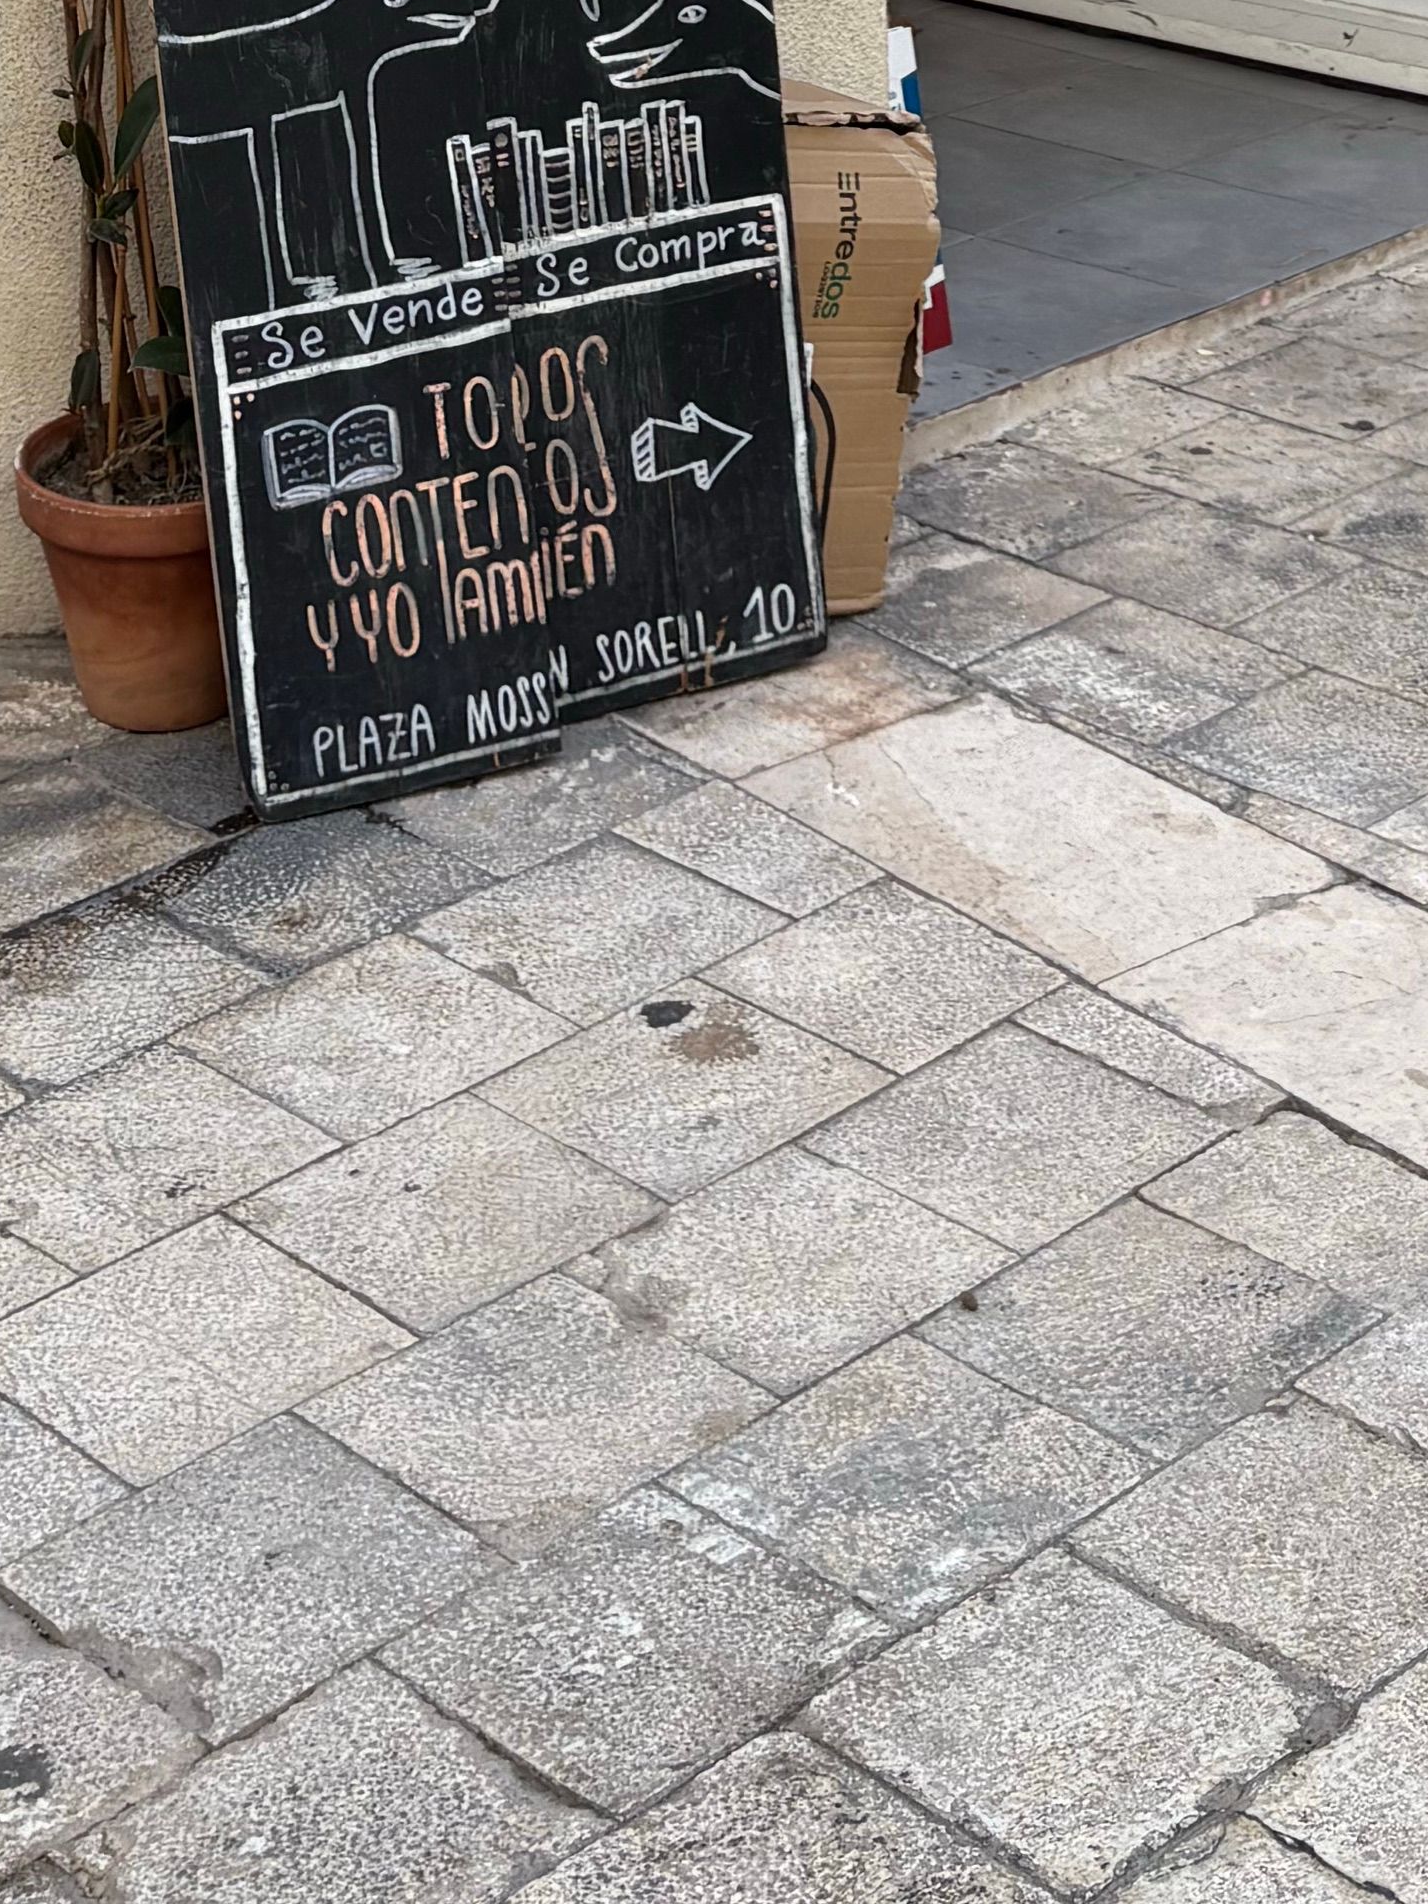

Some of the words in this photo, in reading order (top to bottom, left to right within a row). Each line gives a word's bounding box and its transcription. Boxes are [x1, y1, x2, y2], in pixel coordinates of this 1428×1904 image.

[262, 320, 328, 370] Se
[347, 284, 486, 346] Vende
[535, 255, 590, 297] Se
[613, 219, 767, 275] Compra
[820, 171, 863, 320] Entredos
[321, 436, 620, 589] CONTENOS
[312, 704, 438, 778] PLAZA
[741, 583, 798, 644] 10
